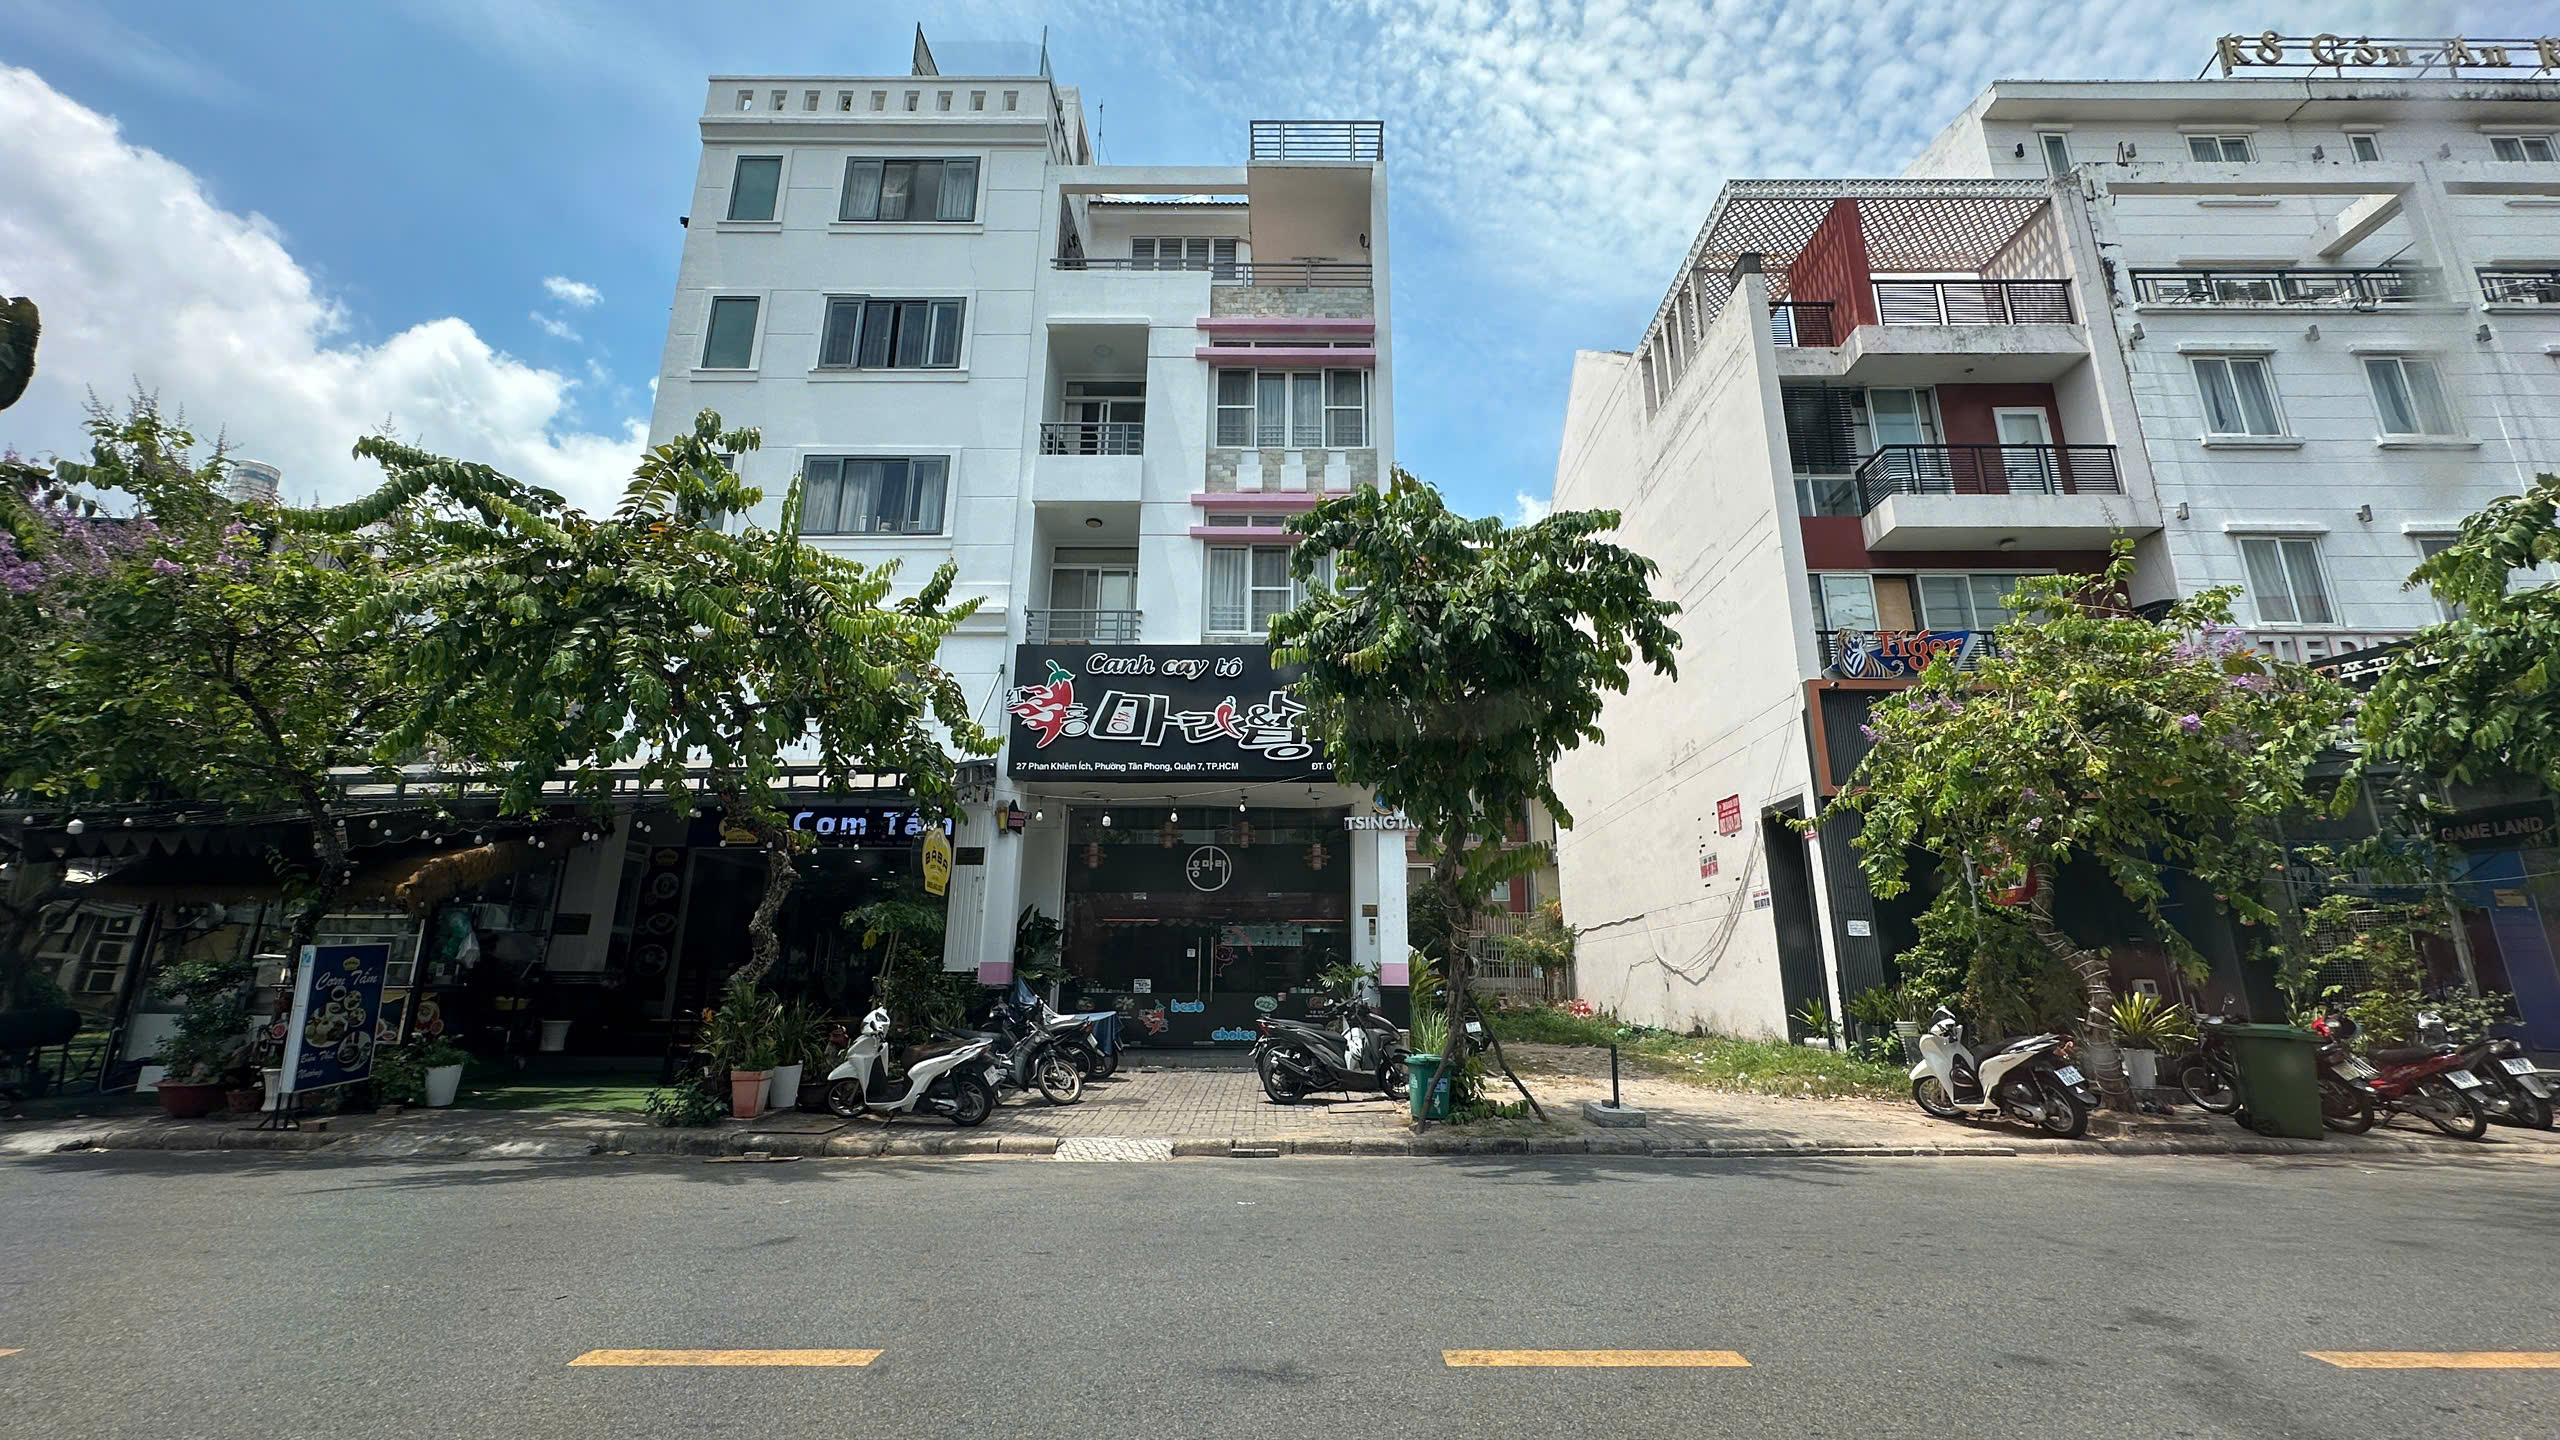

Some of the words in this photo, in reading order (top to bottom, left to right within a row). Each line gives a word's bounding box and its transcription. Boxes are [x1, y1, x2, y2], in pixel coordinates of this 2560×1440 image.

[1874, 628, 1964, 671] Tiger
[1085, 652, 1157, 678] Canh
[1161, 658, 1210, 681] cay
[1214, 655, 1244, 679] tô
[1016, 762, 1027, 771] 27
[1028, 762, 1050, 771] Phan
[1050, 762, 1077, 771] Khiêm
[1095, 761, 1126, 773] Phường
[1128, 761, 1143, 771] Tân
[1174, 762, 1196, 773] Quận
[1206, 762, 1239, 771] TP.HCM
[793, 811, 868, 836] Cơm
[2440, 822, 2492, 842] GAME
[2493, 816, 2544, 837] LAND
[1170, 998, 1205, 1013] best
[1211, 1026, 1257, 1041] choice
